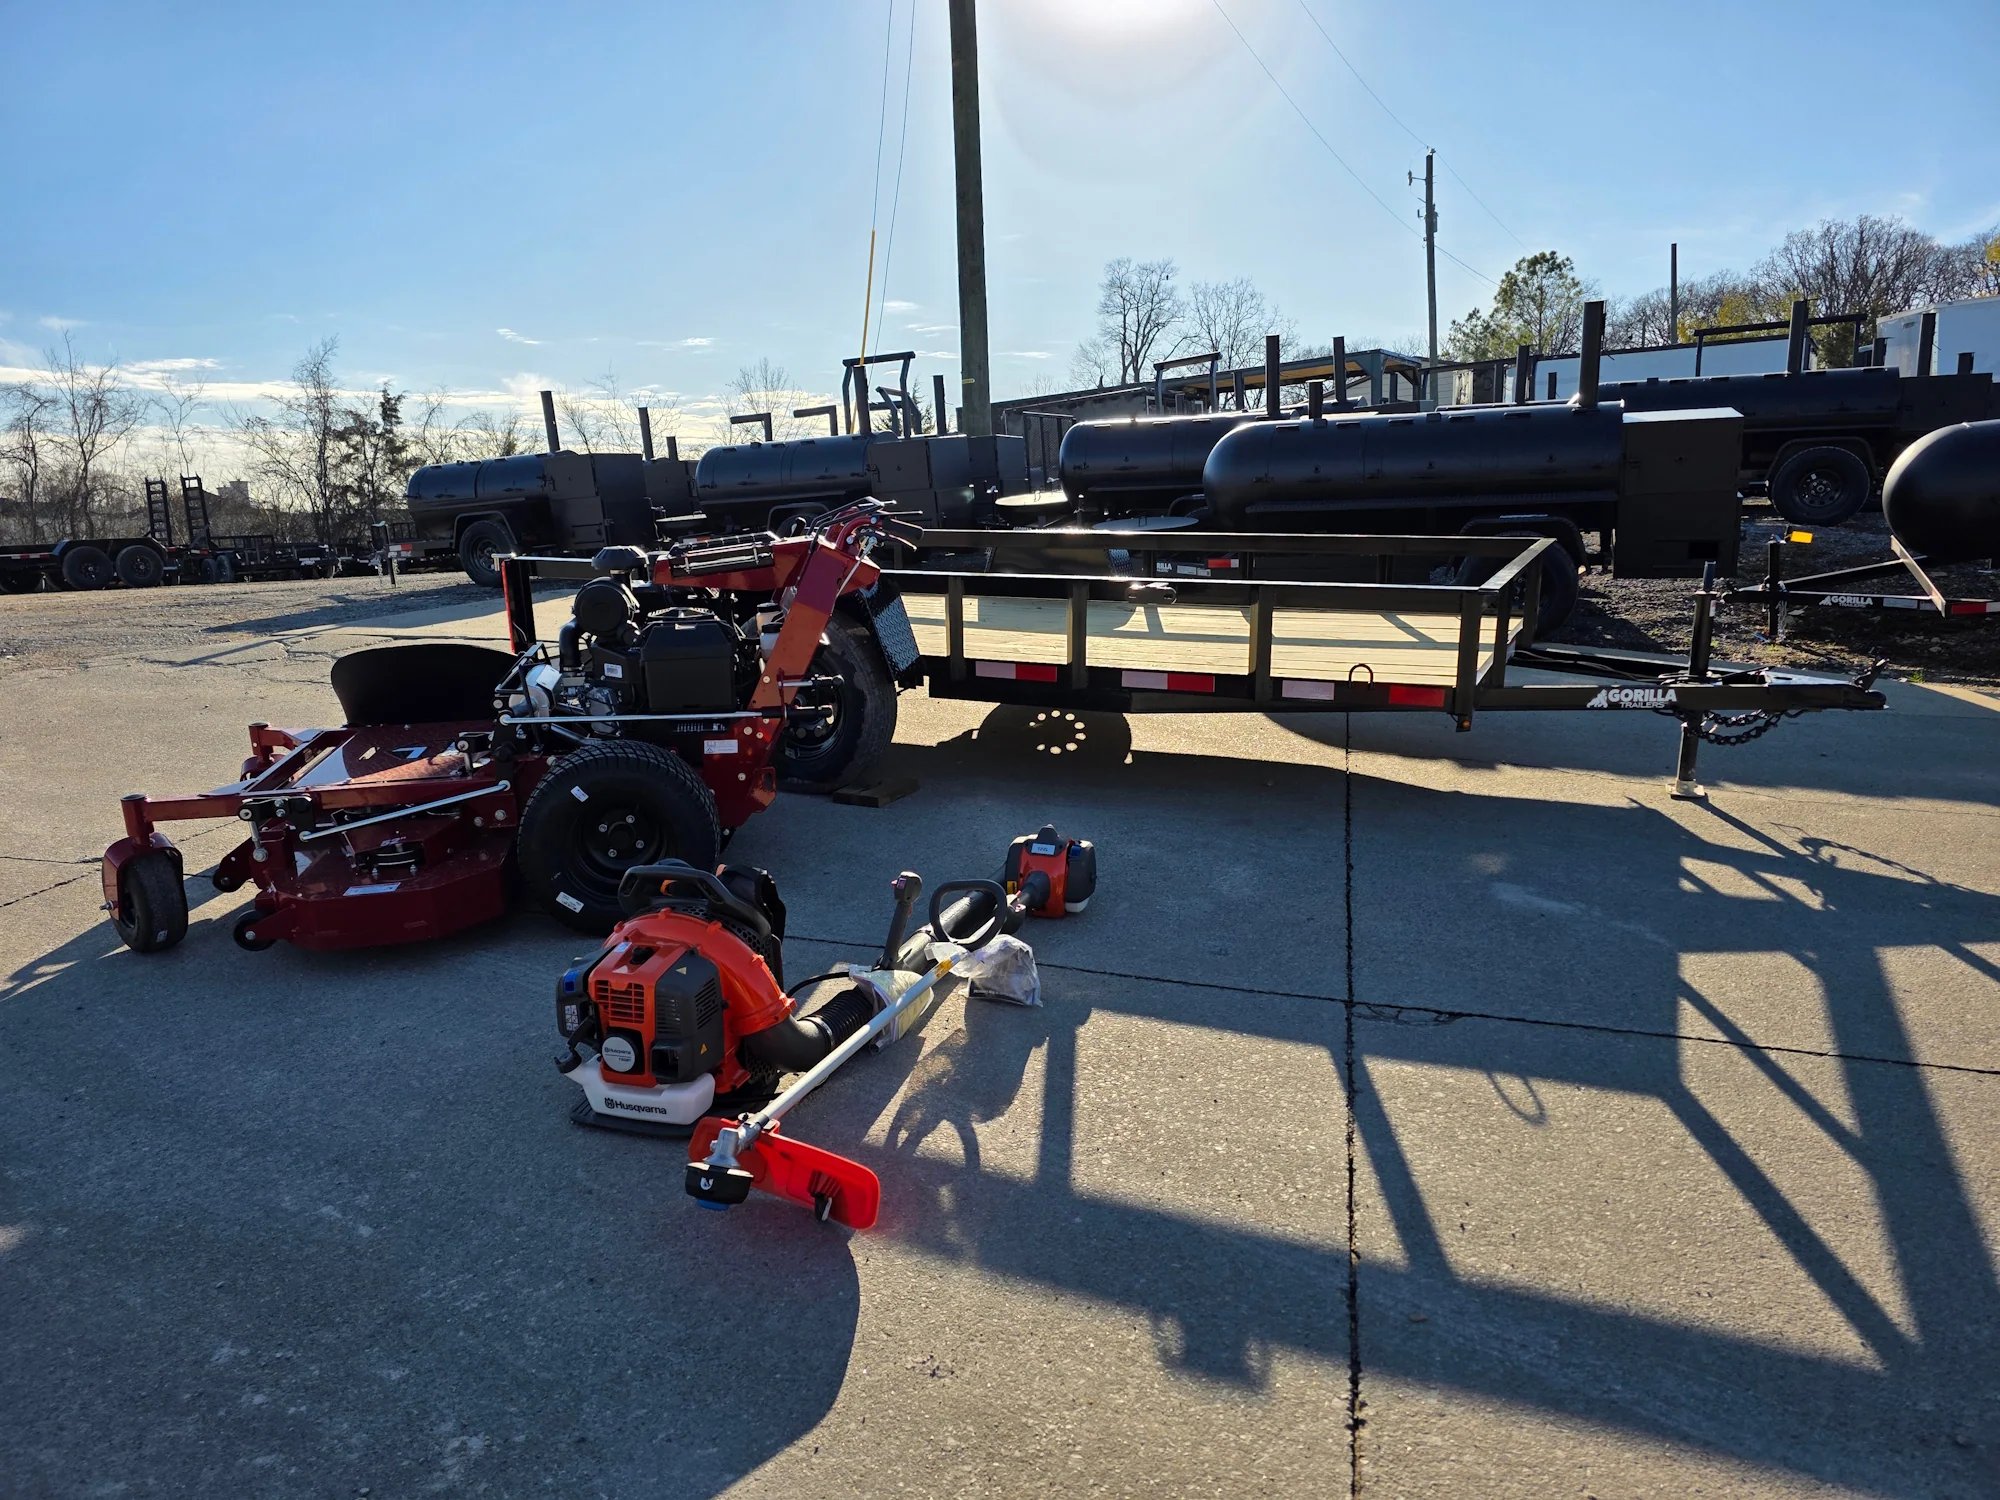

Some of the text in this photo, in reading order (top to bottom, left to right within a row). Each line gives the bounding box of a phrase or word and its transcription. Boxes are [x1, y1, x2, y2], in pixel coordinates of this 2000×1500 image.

[1156, 562, 1172, 570] RILLA
[1831, 596, 1873, 605] GORILLA
[1608, 688, 1677, 702] GORILLA
[615, 1100, 667, 1114] Husqvarna
